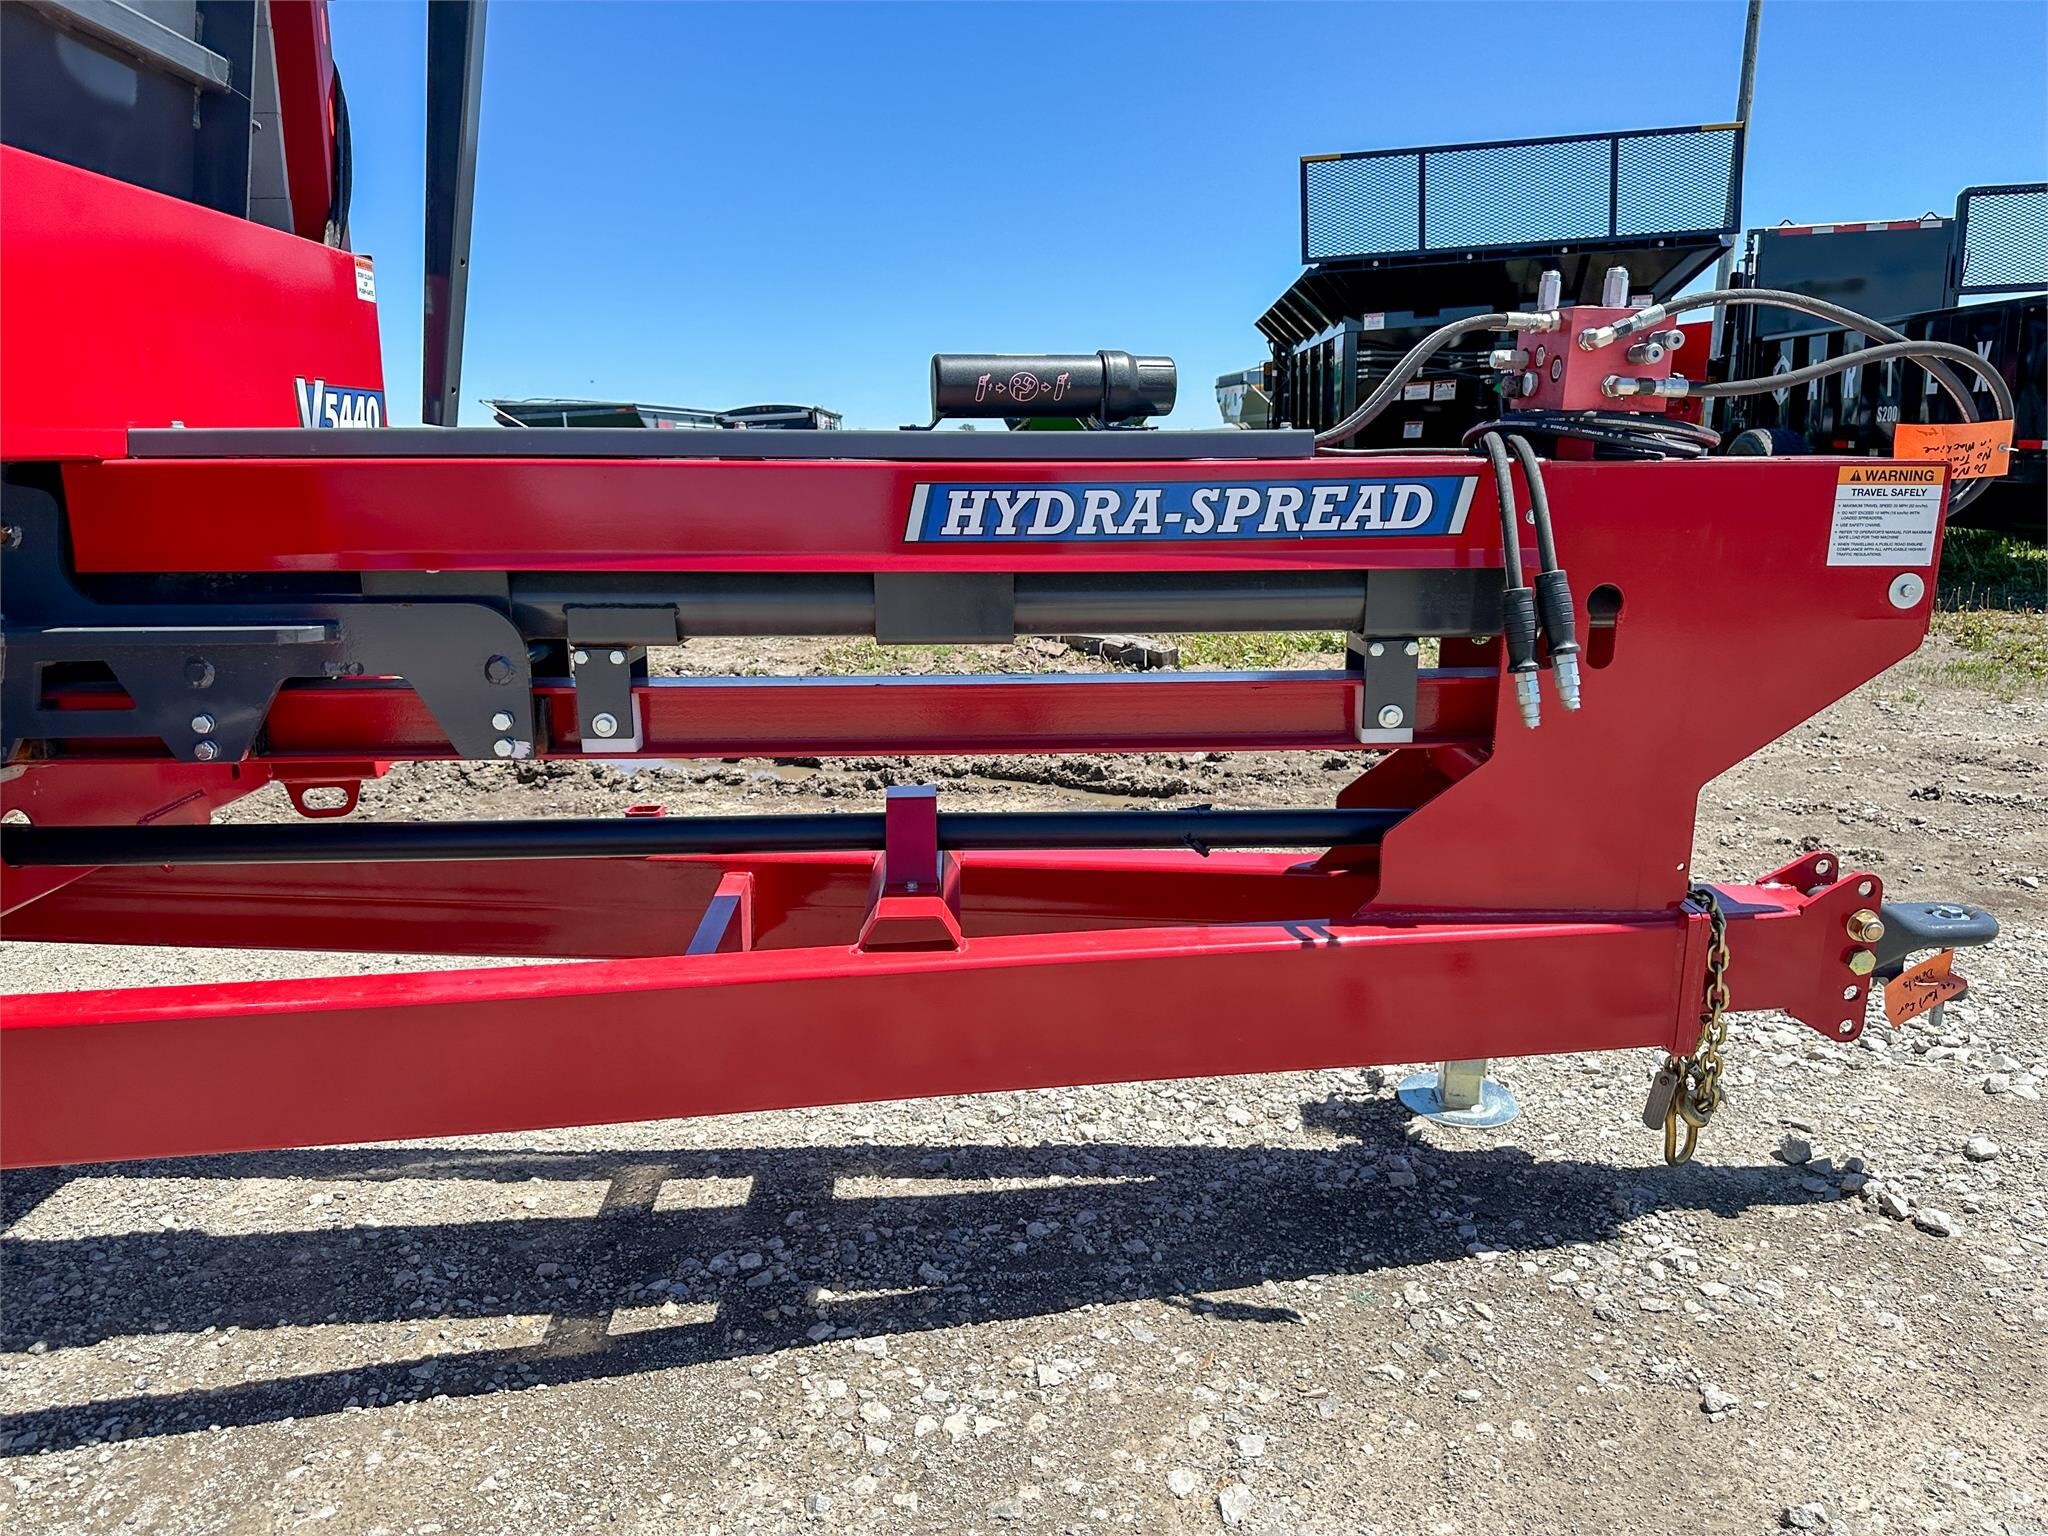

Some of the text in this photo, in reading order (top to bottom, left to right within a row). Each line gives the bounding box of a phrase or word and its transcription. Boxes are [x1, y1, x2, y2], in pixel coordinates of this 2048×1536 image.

[294, 376, 380, 428] V5440
[1876, 405, 1898, 422] S200
[1922, 441, 1975, 454] Machine
[1864, 469, 1935, 482] WARNING
[1951, 465, 1970, 478] No
[1851, 488, 1928, 497] TRAVEL SAFELY
[938, 482, 1437, 536] HYDRA-SPREAD
